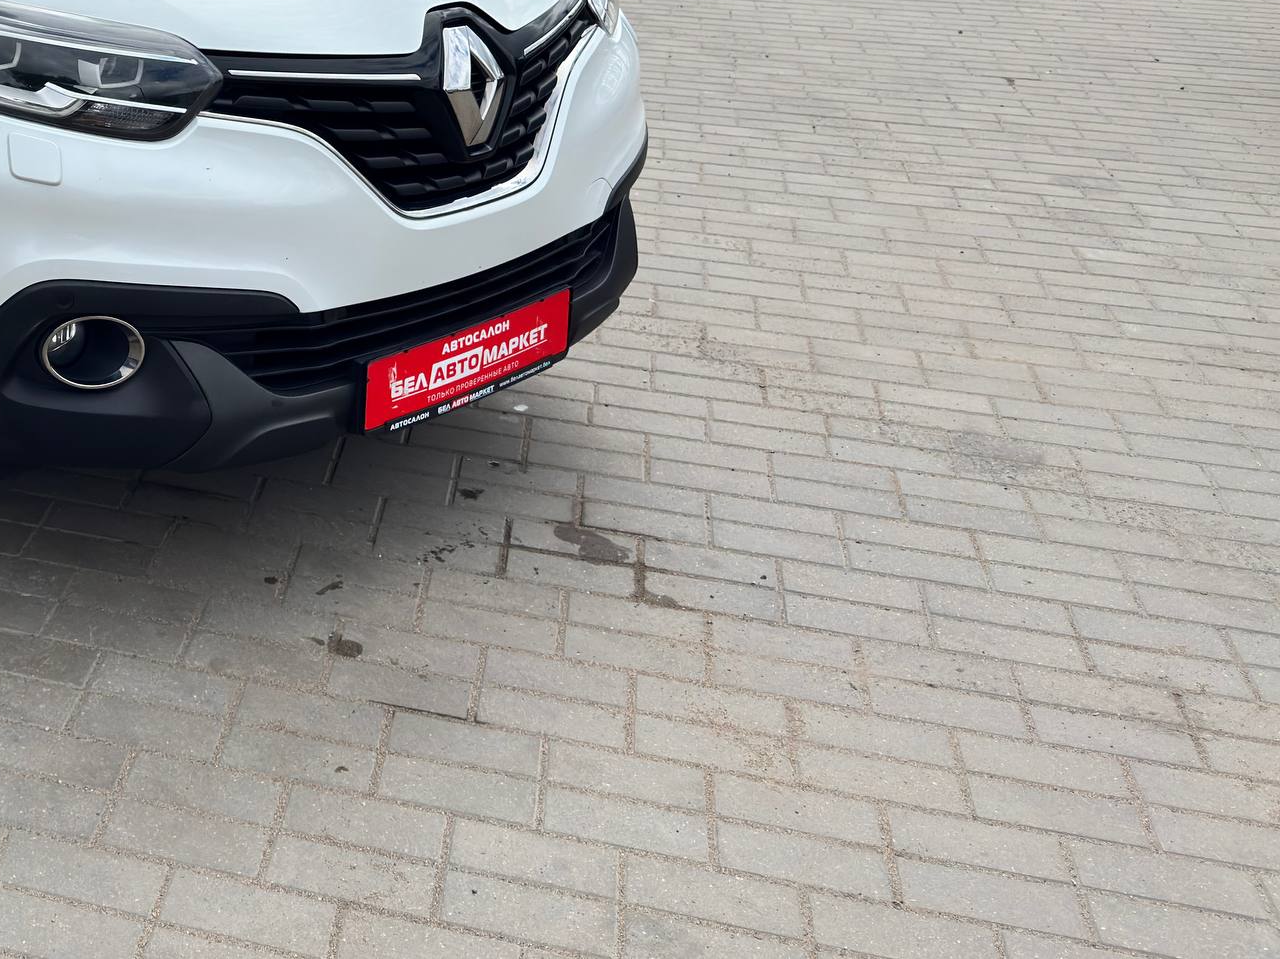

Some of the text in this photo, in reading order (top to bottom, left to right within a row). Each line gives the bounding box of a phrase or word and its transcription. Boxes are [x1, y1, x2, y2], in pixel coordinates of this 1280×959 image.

[441, 320, 510, 355] АВТОСАЛОН
[426, 360, 519, 403] ТОЛЬКО ПРОВЕРЕННЫЕ АВТО
[390, 411, 430, 431] АВТОСАЛОН
